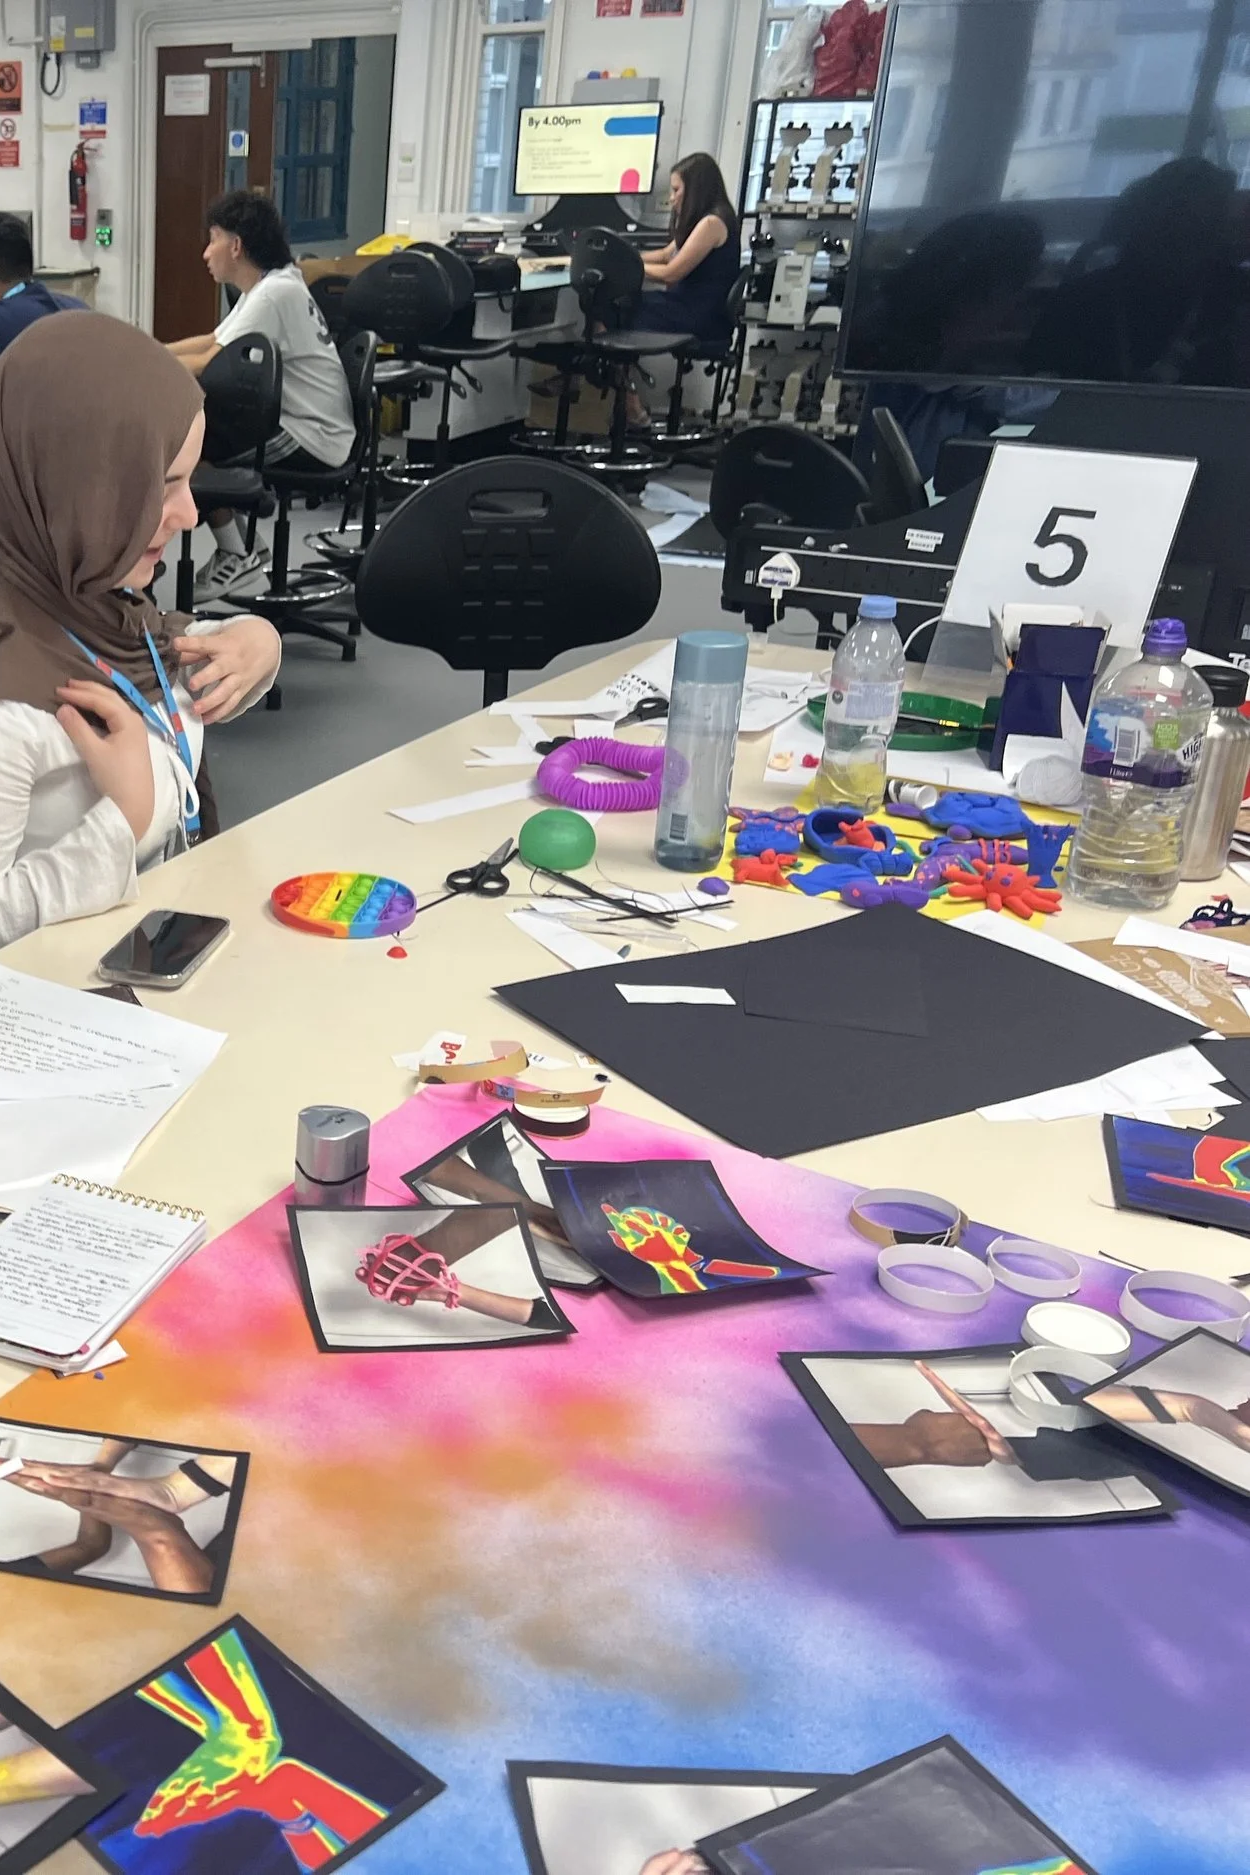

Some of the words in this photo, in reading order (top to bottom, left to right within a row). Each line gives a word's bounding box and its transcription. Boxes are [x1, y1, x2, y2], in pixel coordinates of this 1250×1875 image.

[528, 116, 540, 129] By
[543, 116, 581, 128] 4.00pm
[1025, 506, 1097, 587] 5
